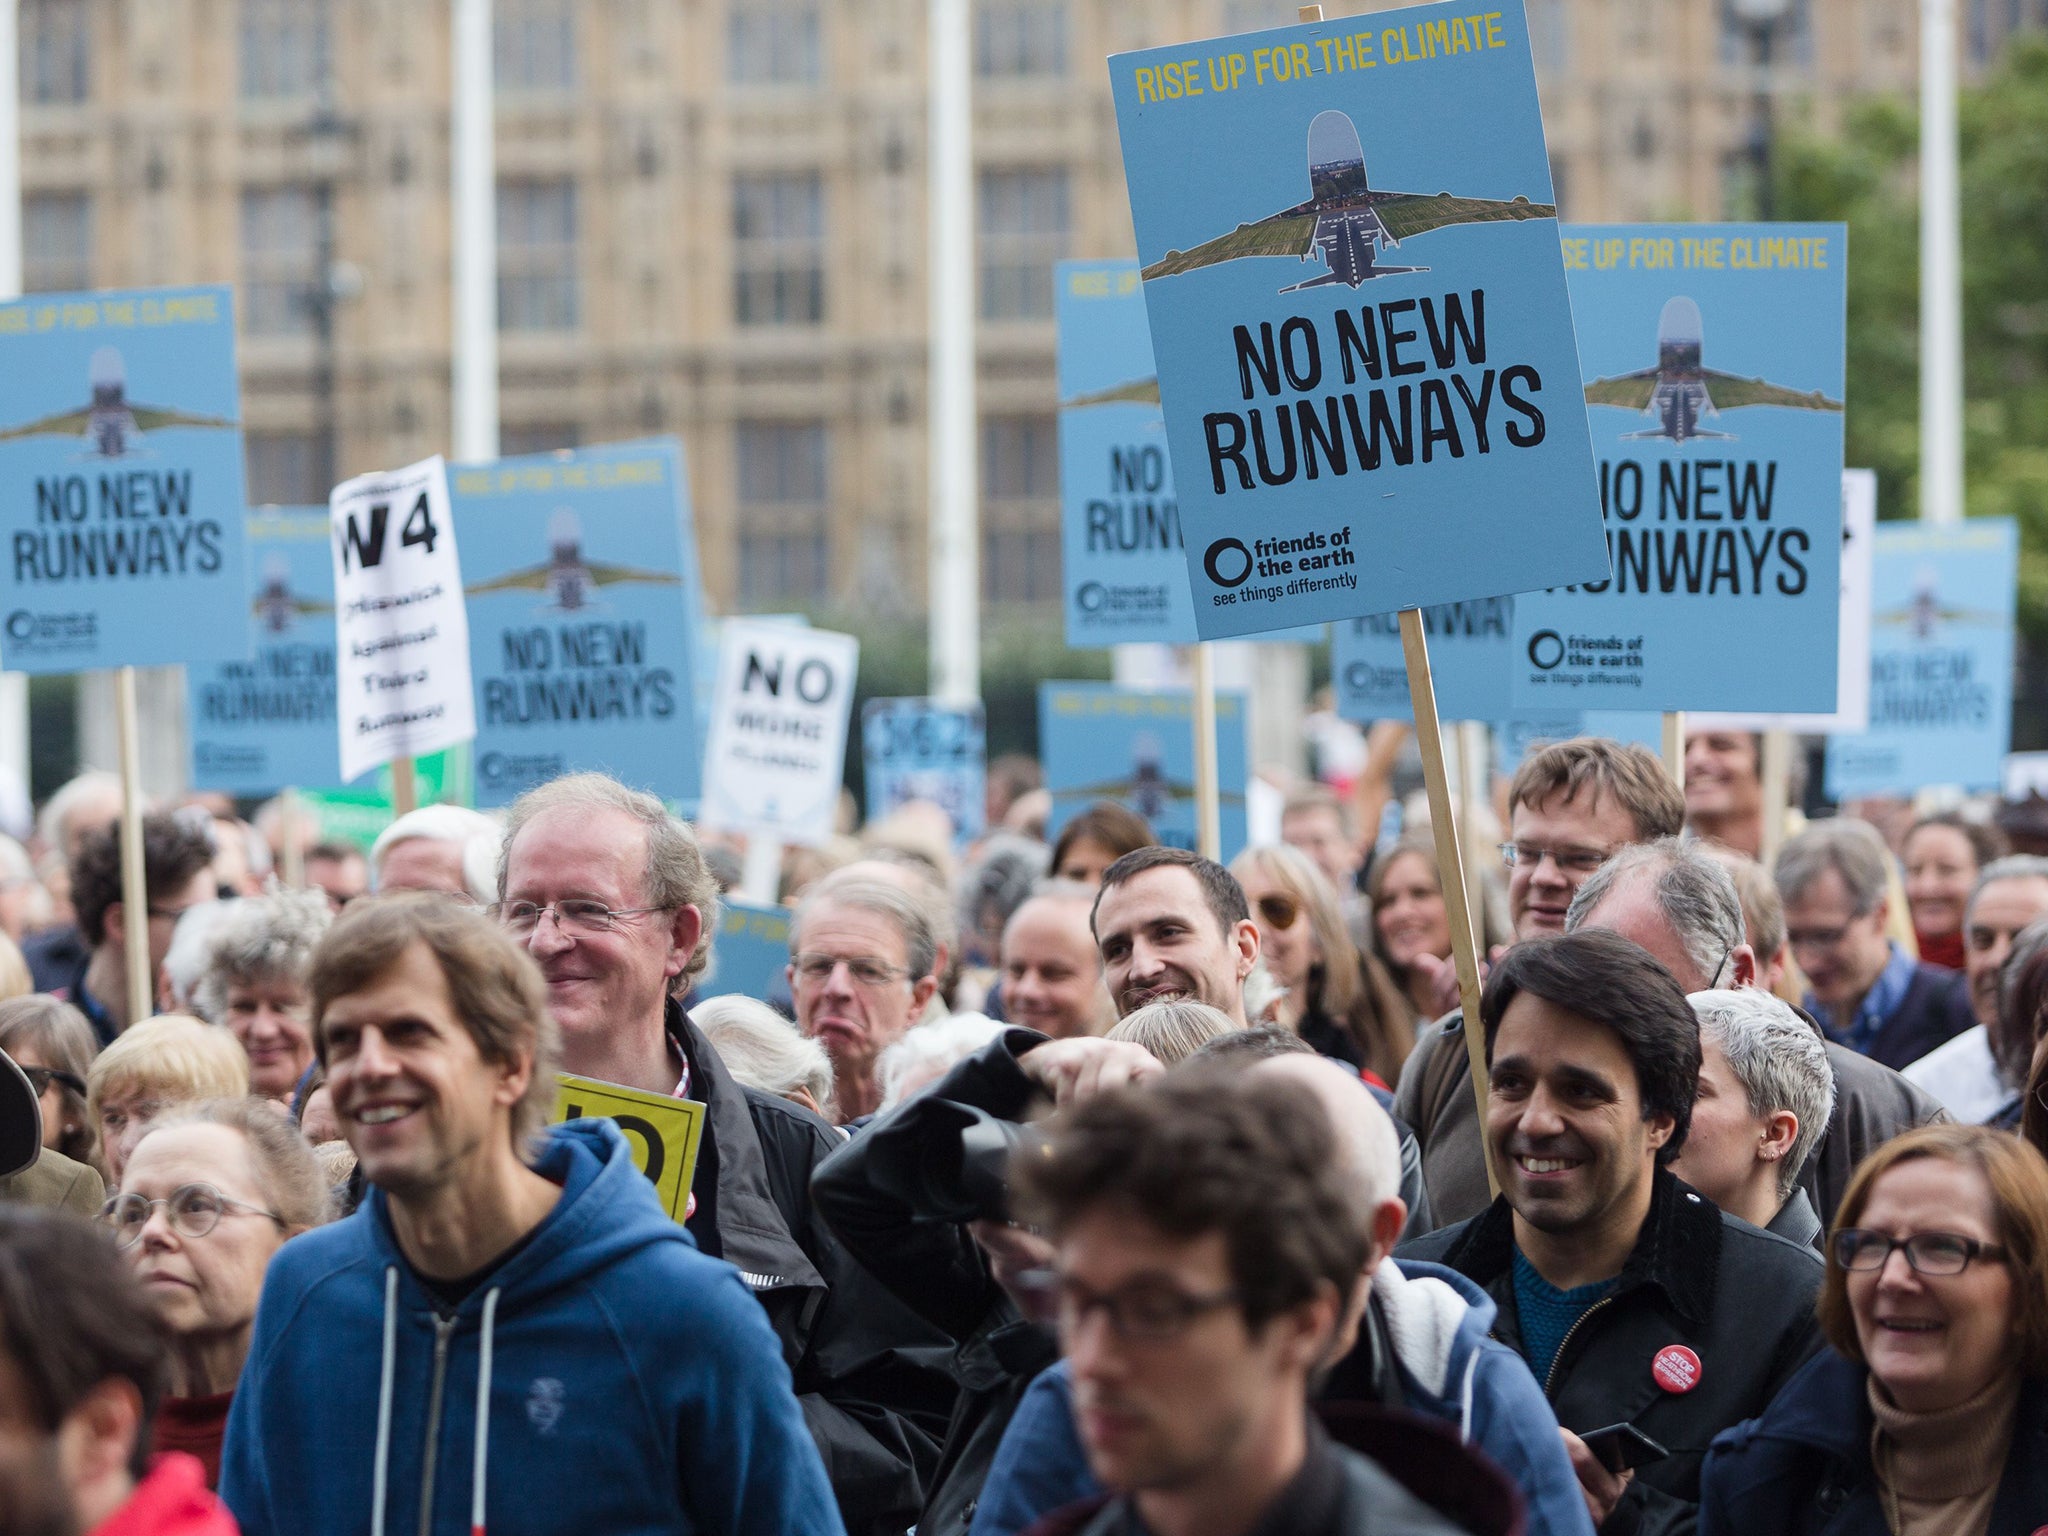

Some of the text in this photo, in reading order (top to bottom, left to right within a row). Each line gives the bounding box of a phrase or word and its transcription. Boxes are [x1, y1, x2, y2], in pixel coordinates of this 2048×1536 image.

[1135, 12, 1506, 104] RISE UP FOR THE CLIMATE
[1562, 238, 1829, 270] SE UP FOR THE CLIMATE
[1233, 288, 1486, 400] NO NEW
[1203, 364, 1546, 494] RUNWAYS
[36, 468, 192, 522] NO NEW
[1110, 445, 1164, 494] NO
[1659, 459, 1777, 521] NEW
[13, 519, 222, 583] RUNWAYS
[1085, 499, 1184, 552] RUN
[1254, 526, 1351, 558] friends of
[1257, 547, 1355, 578] the earth
[1546, 528, 1811, 595] NWAYS
[1213, 571, 1358, 606] see things differently
[503, 619, 646, 672] NO NEW
[1567, 634, 1644, 650] friends of
[1567, 651, 1644, 667] the earth
[483, 667, 676, 726] RUNWAYS
[741, 650, 834, 704] NO
[1669, 1351, 1695, 1373] STOP
